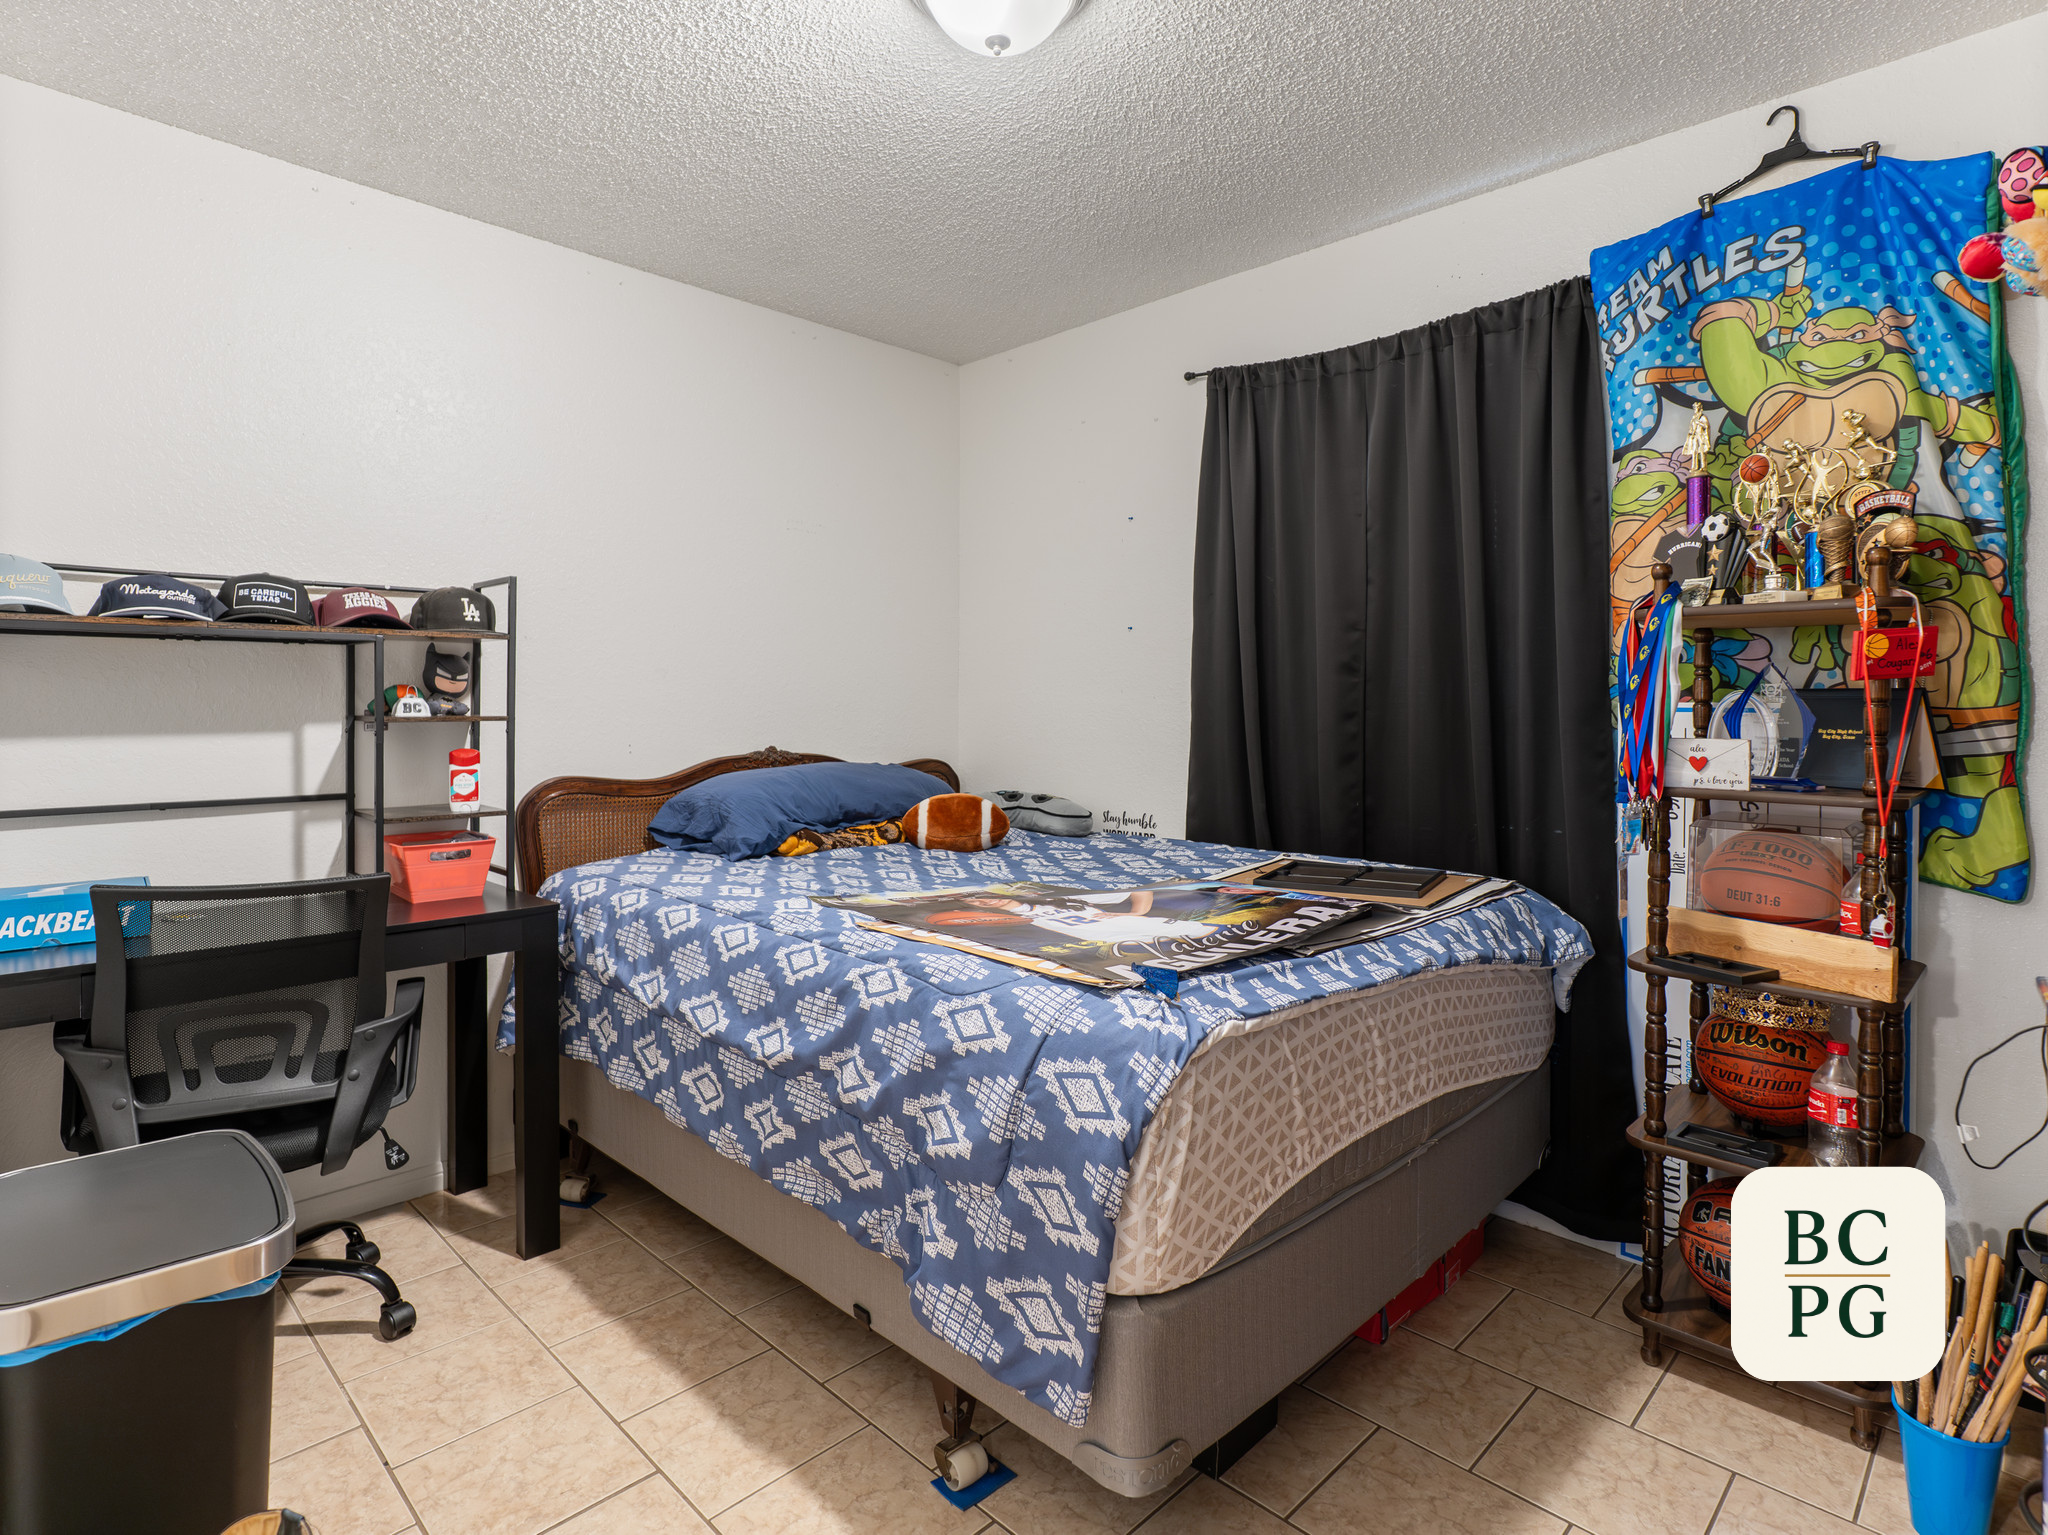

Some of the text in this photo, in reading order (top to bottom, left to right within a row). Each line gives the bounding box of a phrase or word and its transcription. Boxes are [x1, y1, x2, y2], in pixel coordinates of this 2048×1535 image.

[1858, 493, 1911, 513] BASKETBALL
[1667, 541, 1703, 556] HURRICAN
[119, 583, 197, 601] Matagorda
[238, 588, 293, 602] BE CAREFUL,
[250, 594, 281, 604] TEXAS
[344, 597, 388, 612] AGGIES
[460, 597, 481, 622] LA
[402, 702, 422, 713] BC
[1712, 775, 1728, 785] love
[1729, 778, 1744, 788] you
[1122, 810, 1158, 830] humble
[1726, 888, 1782, 908] DEUT 31:6
[1112, 918, 1261, 960] Valerie
[1709, 1022, 1809, 1063] Wilson
[1710, 1065, 1802, 1093] EVOLUTION
